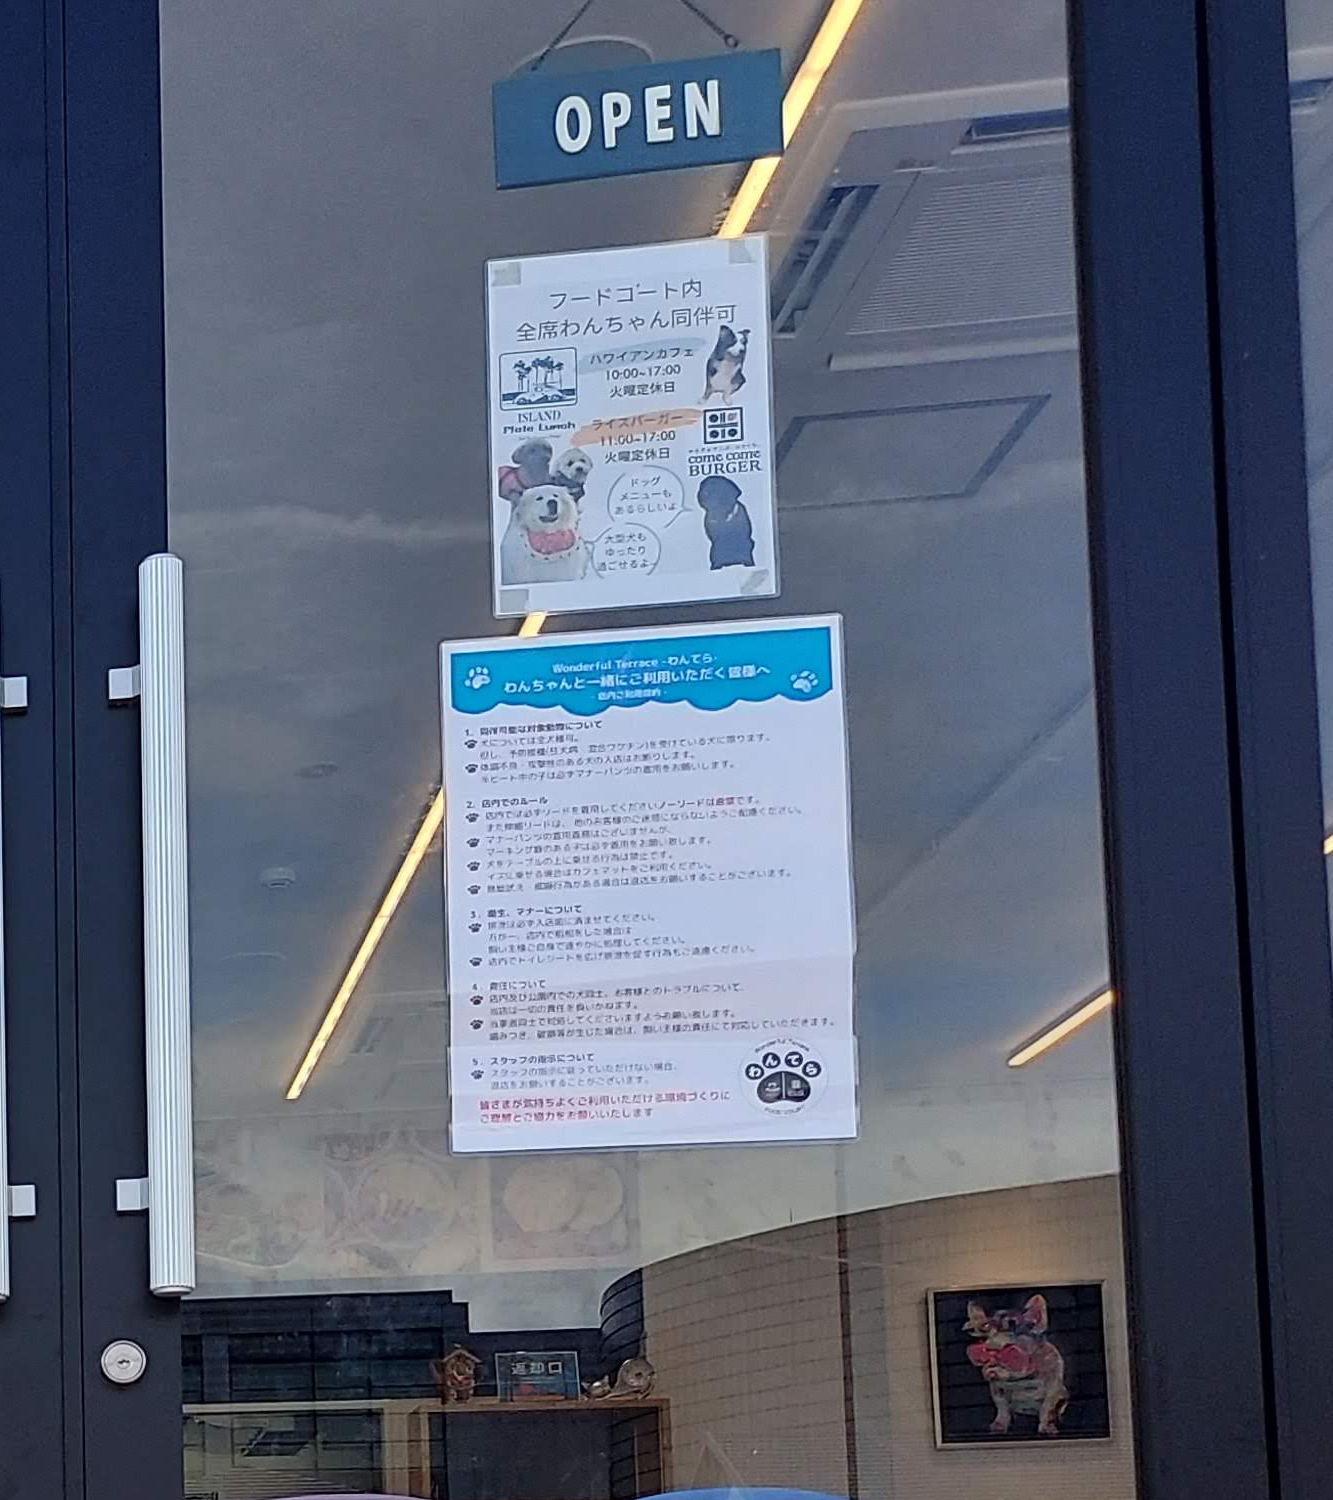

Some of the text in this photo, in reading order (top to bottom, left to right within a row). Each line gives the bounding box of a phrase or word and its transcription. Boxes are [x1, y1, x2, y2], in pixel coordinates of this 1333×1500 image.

[555, 79, 721, 154] OPEN
[550, 279, 702, 309] フードコート内
[516, 304, 737, 342] 全席わんちゃん同伴可
[590, 348, 694, 365] ハワイアンカフェ
[609, 382, 675, 398] 火曜定休日
[517, 410, 562, 423] ISLAND
[592, 414, 683, 431] ライスバーガー
[604, 448, 670, 464] 火曜定休日
[689, 460, 763, 477] BURGER
[552, 661, 611, 674] Wonderful
[615, 658, 658, 670] Terrace
